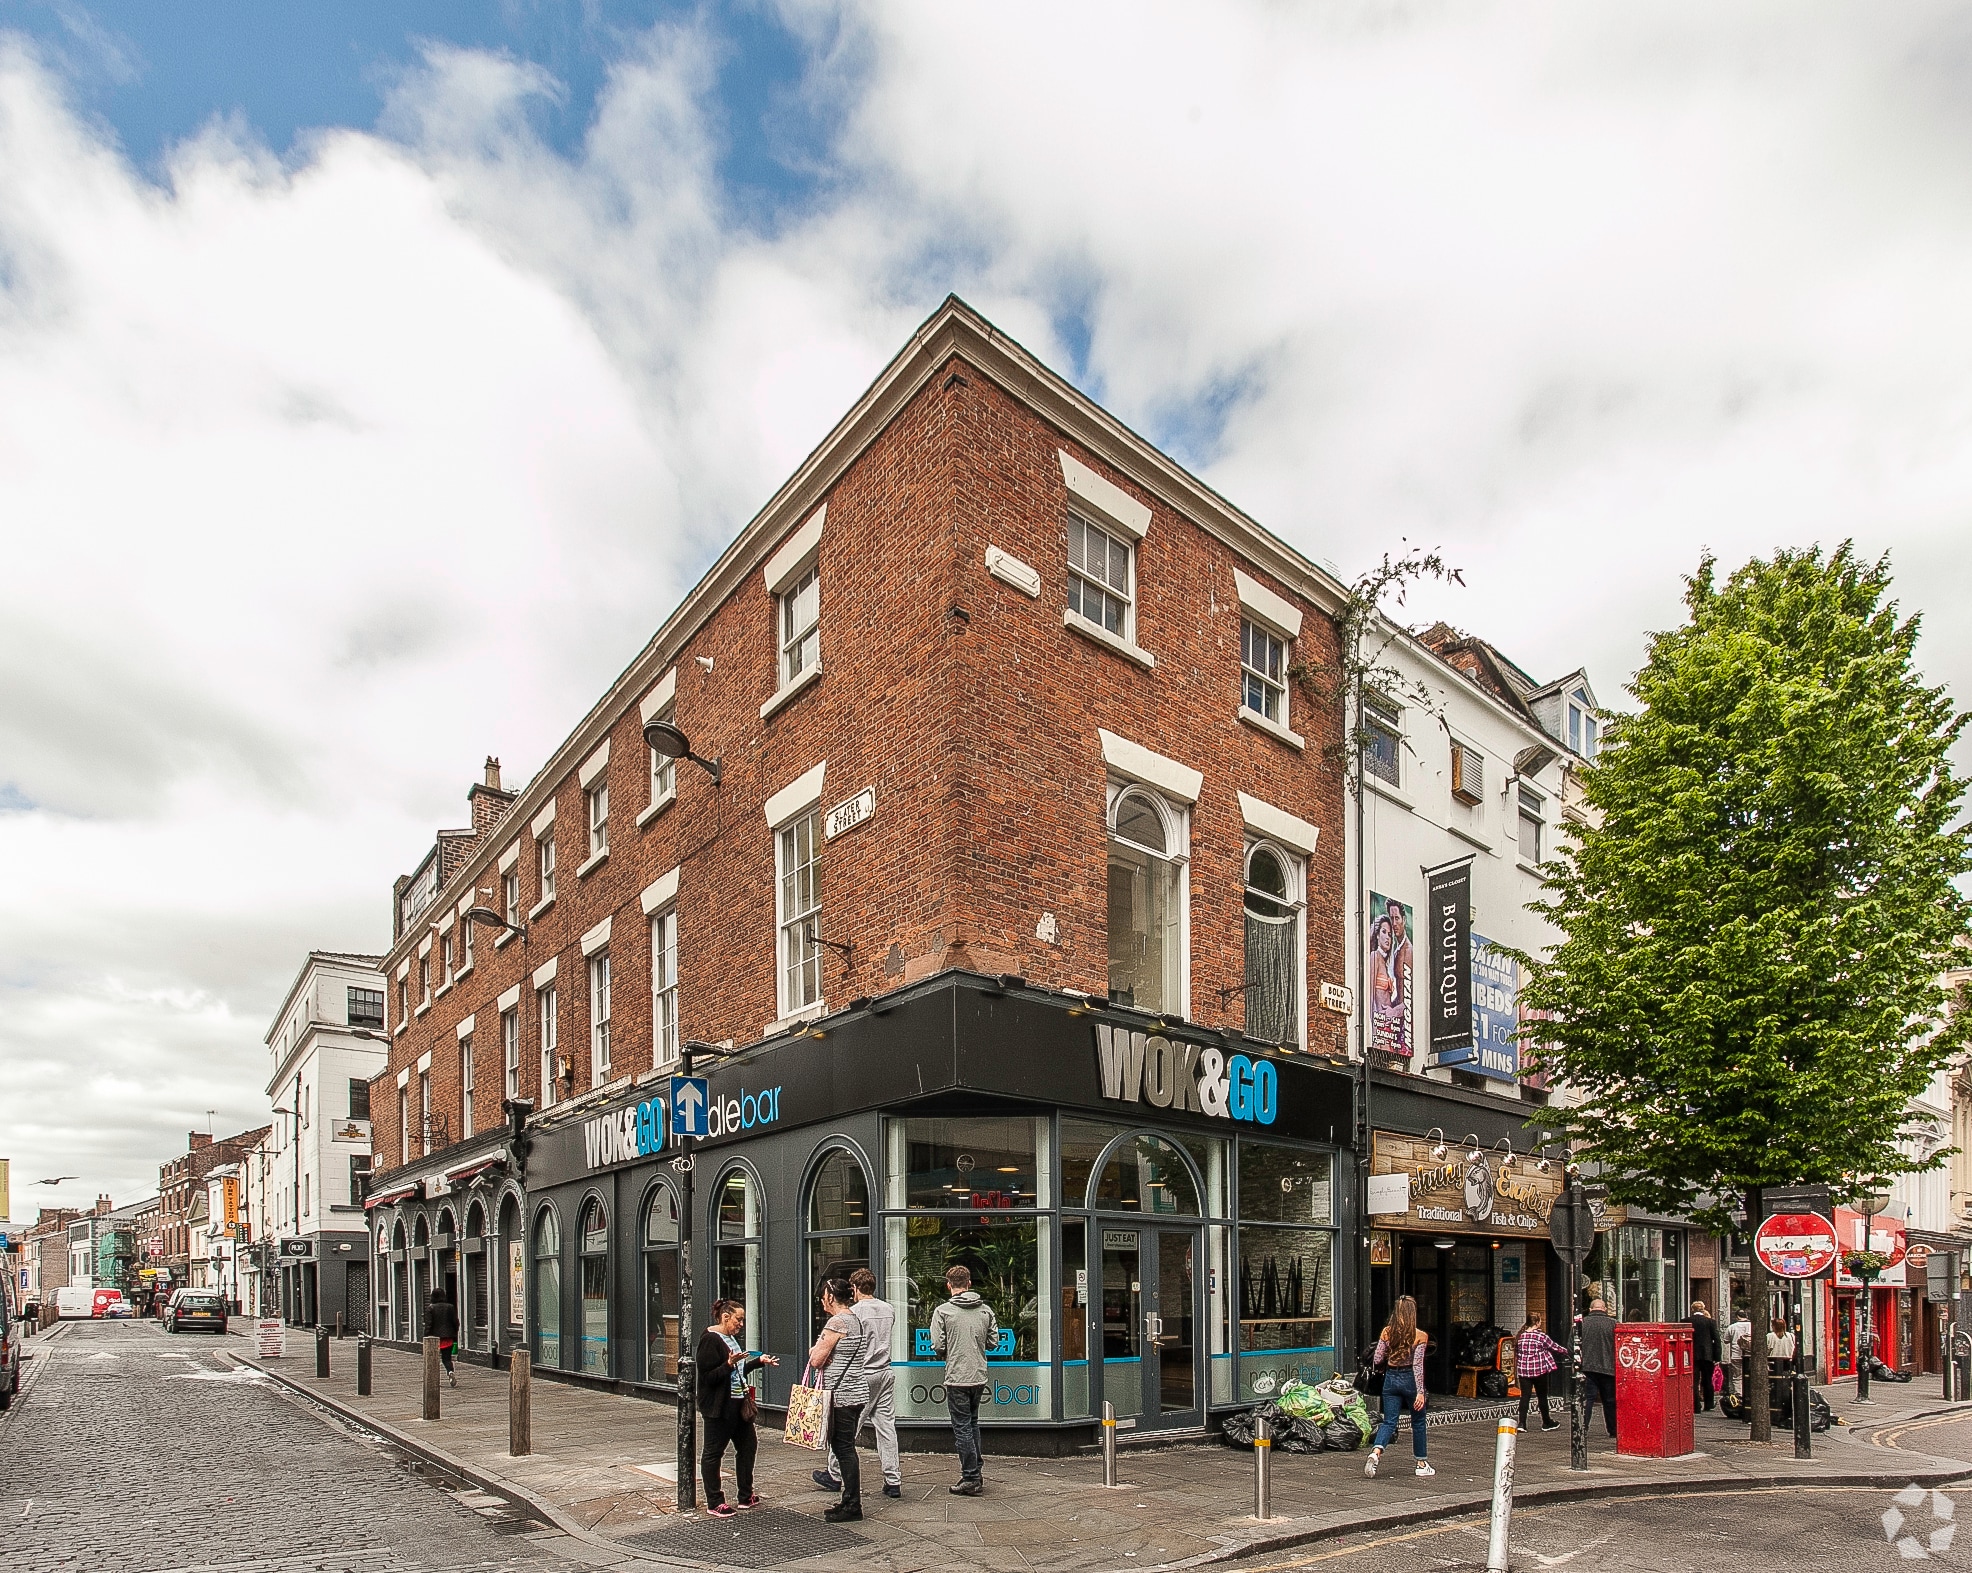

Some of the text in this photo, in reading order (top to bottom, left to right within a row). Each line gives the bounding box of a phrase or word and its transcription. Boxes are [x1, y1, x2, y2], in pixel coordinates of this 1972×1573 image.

[833, 810, 861, 833] STREET
[834, 800, 860, 822] SLATER
[1440, 903, 1457, 1018] BOUTIQUE
[1325, 997, 1346, 1009] STREET
[1328, 986, 1345, 998] BOLD
[1403, 964, 1412, 1048] MEGATAN
[1096, 1024, 1277, 1125] WOK&GO
[1482, 1048, 1513, 1075] MINS
[584, 1096, 666, 1169] WOK&GO
[1407, 1161, 1465, 1201] ohnny
[1417, 1205, 1538, 1231] Traditional Fish & Chips
[1105, 1233, 1136, 1243] JUST EAT
